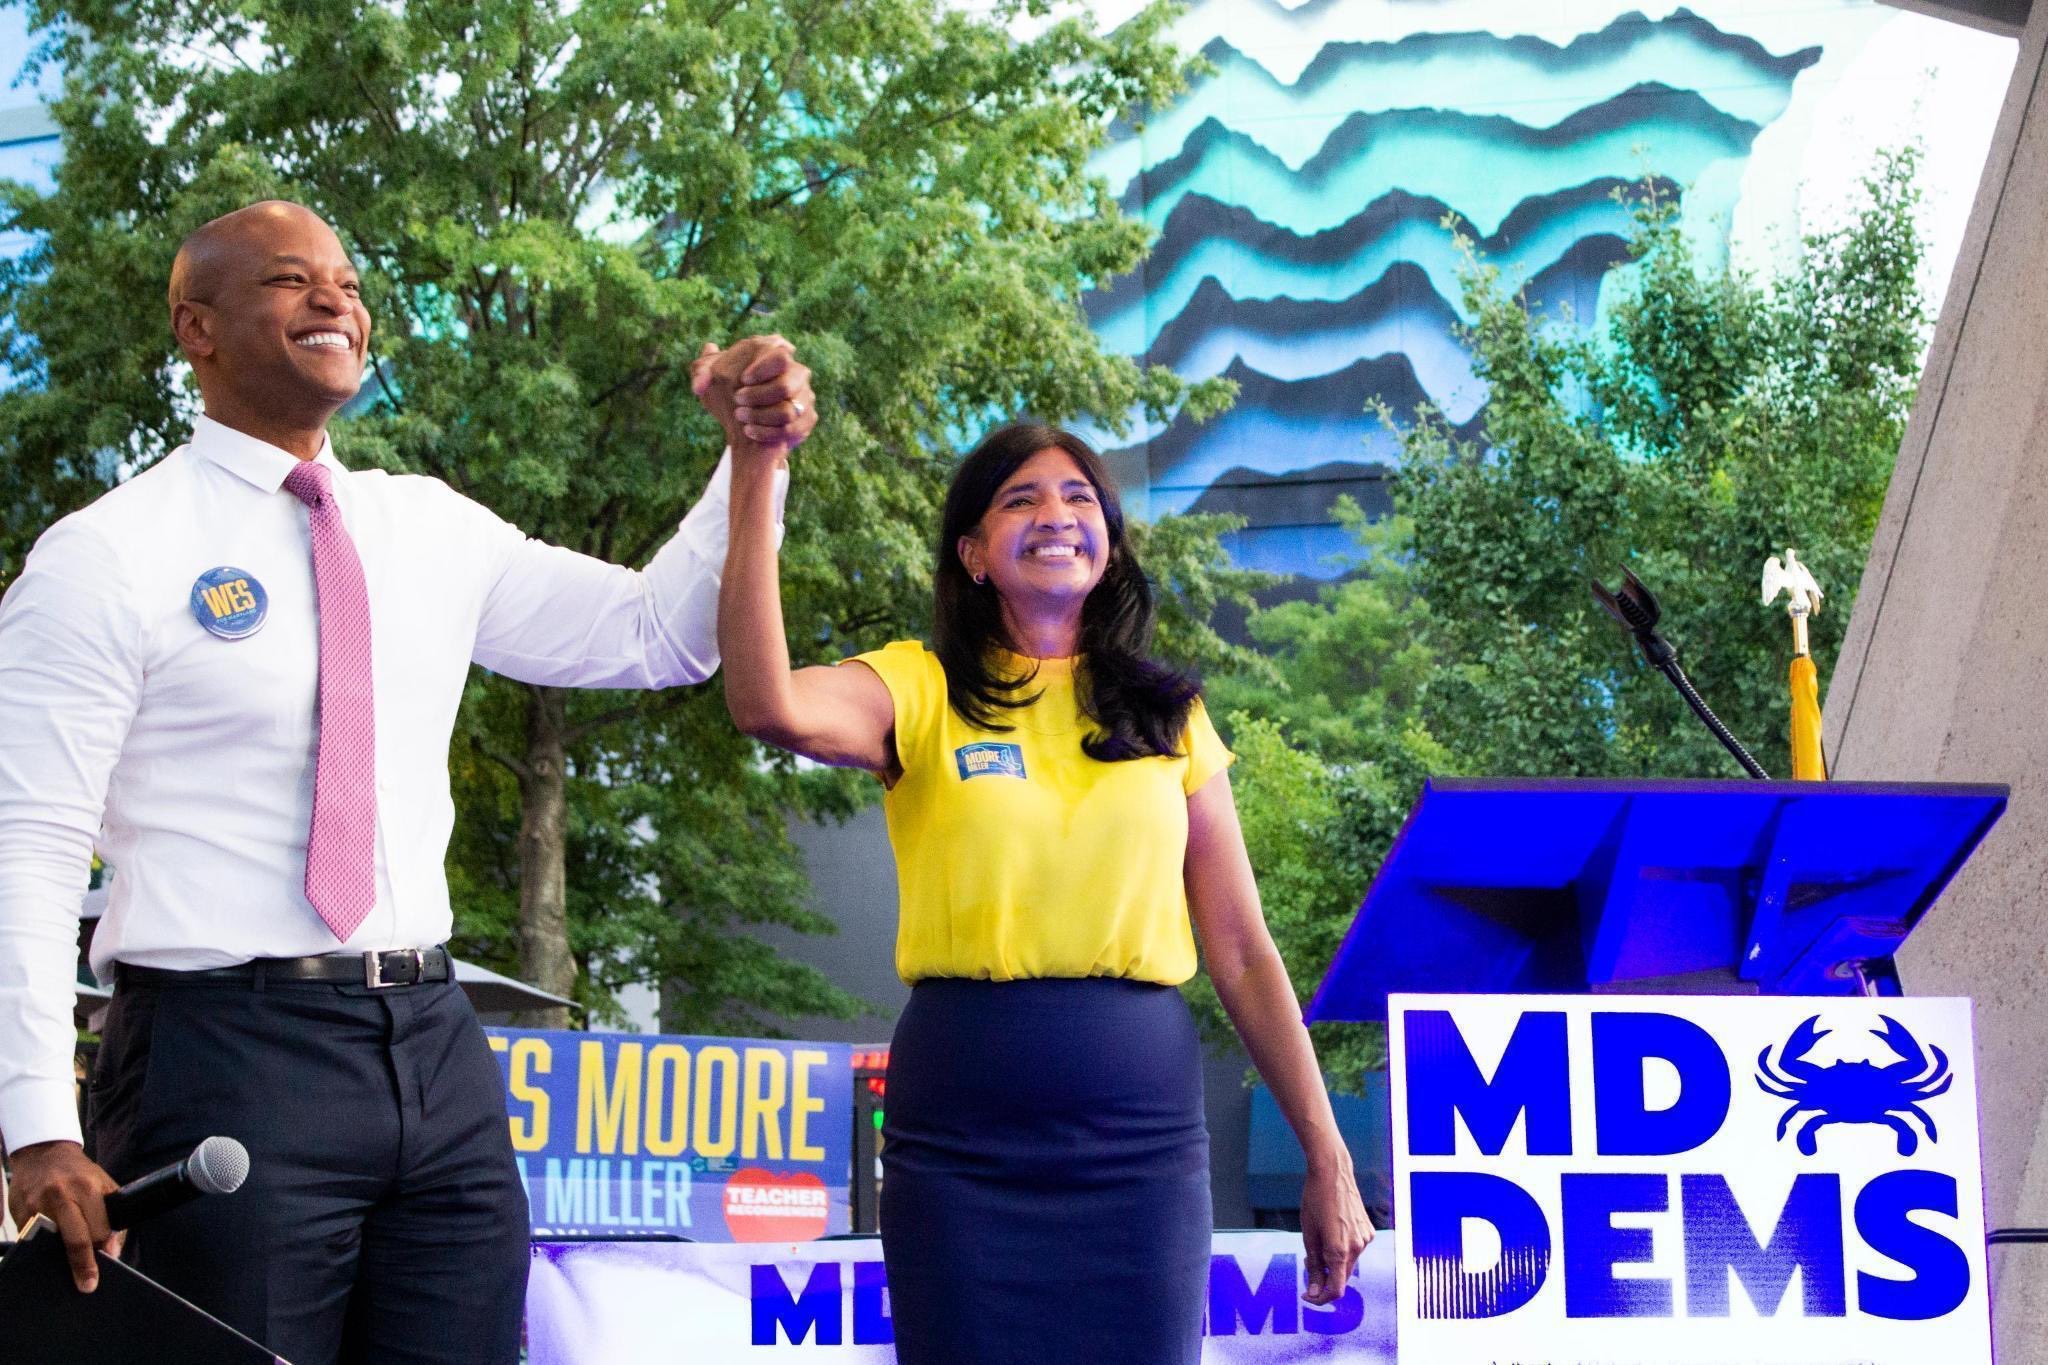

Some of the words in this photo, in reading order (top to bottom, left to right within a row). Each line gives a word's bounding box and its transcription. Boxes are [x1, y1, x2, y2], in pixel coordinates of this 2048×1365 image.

[201, 579, 256, 618] WES
[965, 750, 1001, 765] MOORE
[487, 1036, 552, 1152] S
[576, 1039, 828, 1161] MOORE
[1403, 1010, 1731, 1155] MD
[546, 1157, 693, 1228] MILLER
[726, 1187, 827, 1206] TEACHER
[1409, 1169, 1971, 1320] DEMS
[1202, 1253, 1365, 1337] MS
